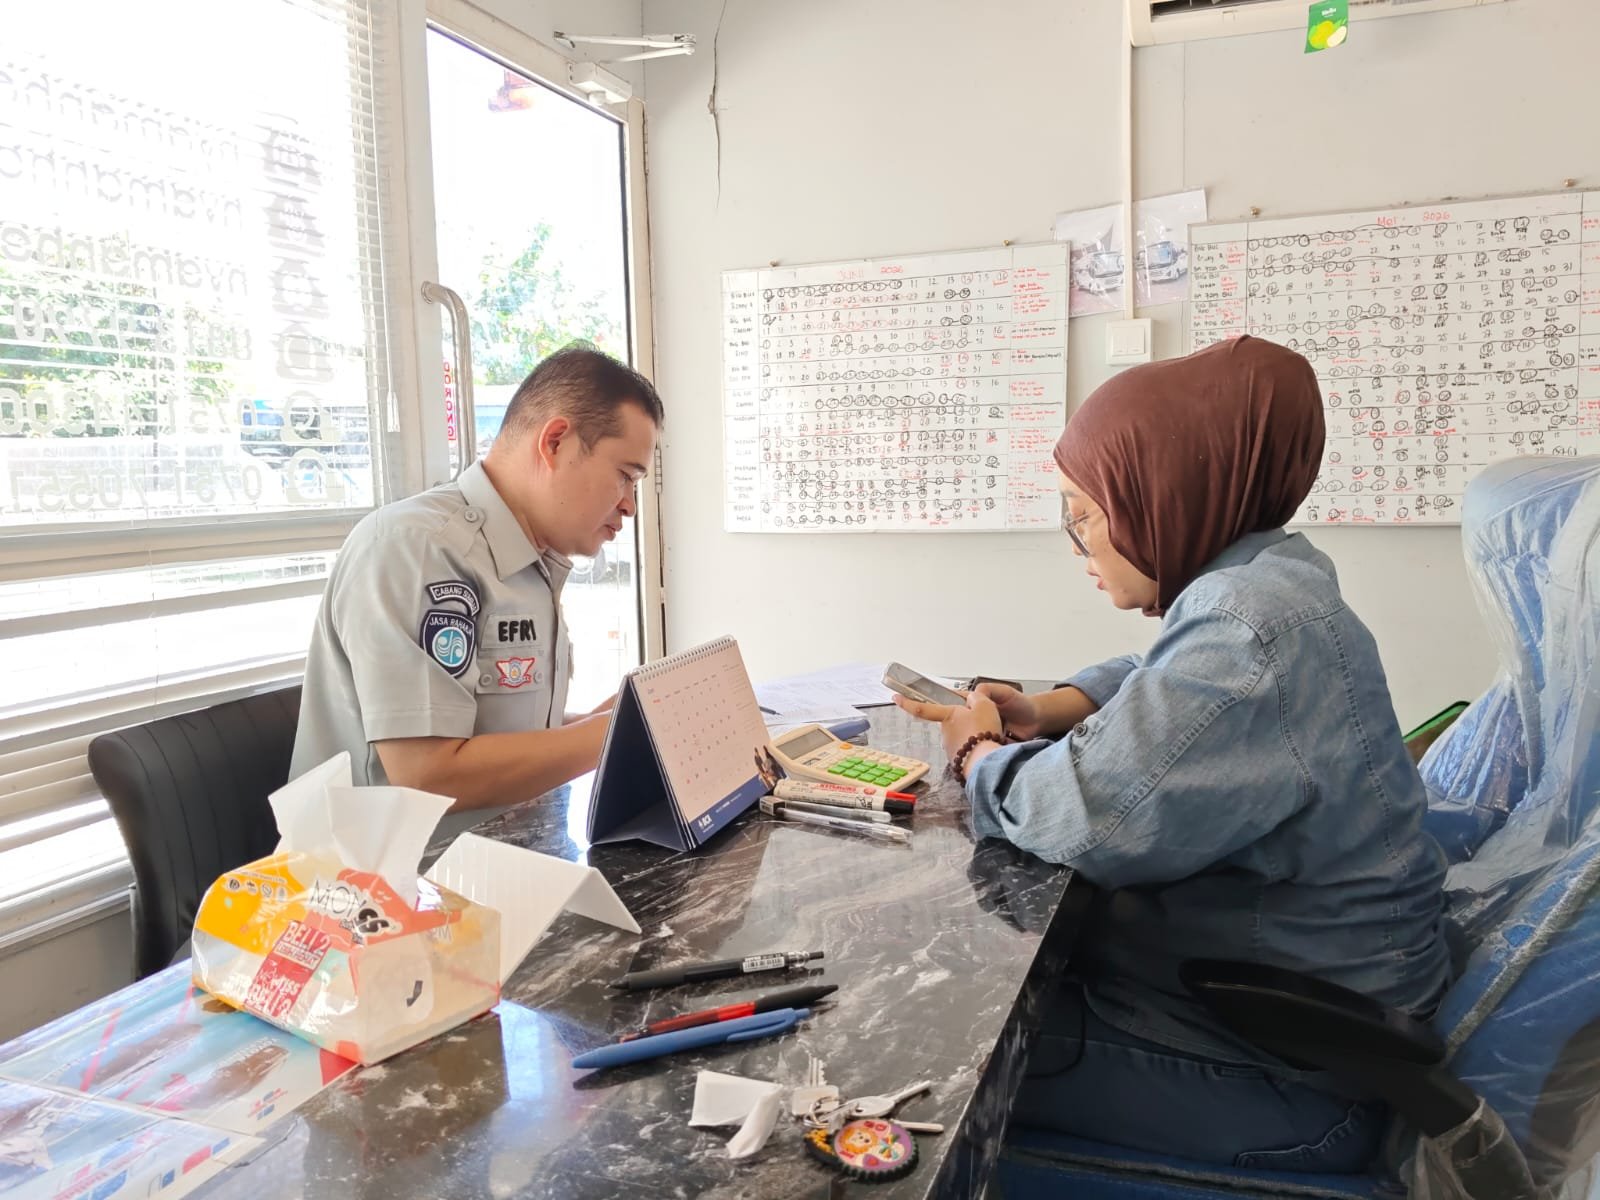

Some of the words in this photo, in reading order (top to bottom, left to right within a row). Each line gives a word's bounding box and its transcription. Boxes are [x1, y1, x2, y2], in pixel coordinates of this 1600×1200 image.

[1424, 211, 1450, 222] 2026
[881, 265, 903, 273] 2026
[434, 587, 462, 597] CABANG
[429, 617, 449, 626] JASA
[498, 619, 536, 642] EFRI
